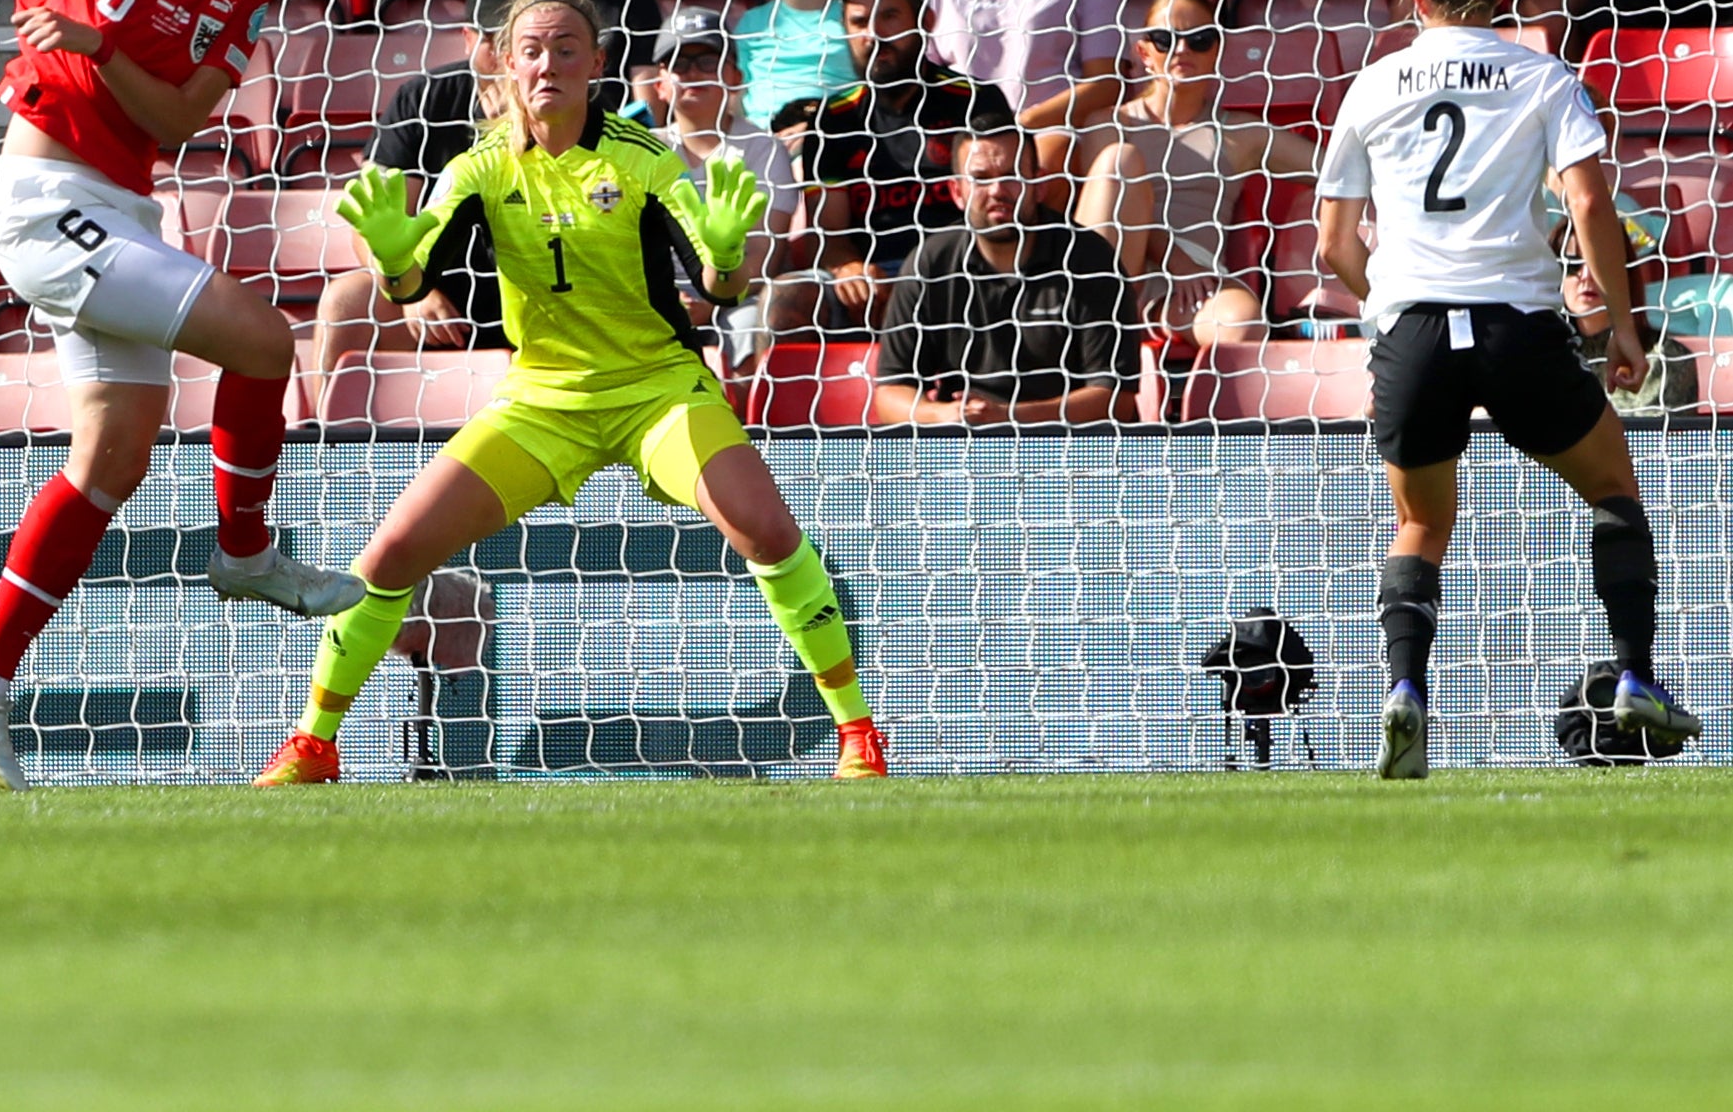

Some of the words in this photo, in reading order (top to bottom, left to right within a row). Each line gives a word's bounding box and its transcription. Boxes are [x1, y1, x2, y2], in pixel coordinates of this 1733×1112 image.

[1397, 60, 1510, 96] McKENNA
[1423, 100, 1467, 213] 2
[56, 208, 108, 252] 6
[547, 236, 573, 293] 1
